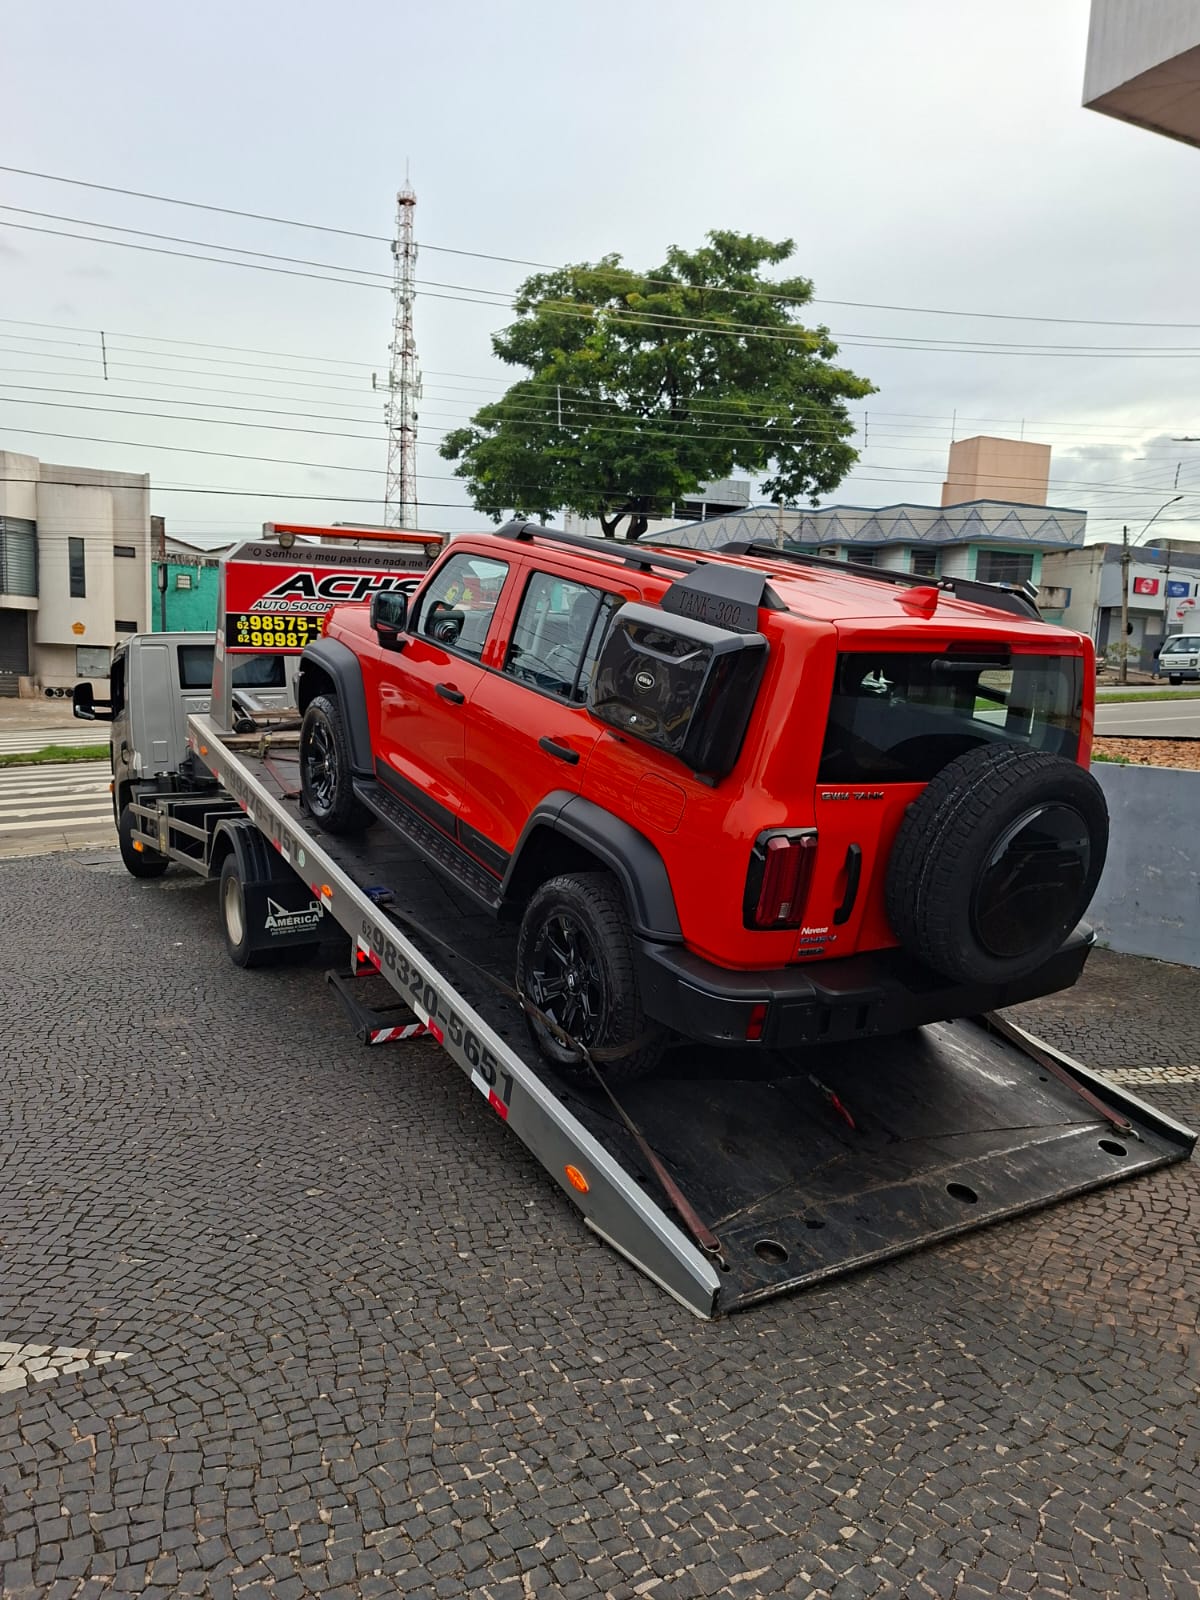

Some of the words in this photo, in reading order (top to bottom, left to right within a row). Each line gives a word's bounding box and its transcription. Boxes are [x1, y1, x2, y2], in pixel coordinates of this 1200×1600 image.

[265, 549, 303, 560] Senhor
[315, 553, 337, 562] meu
[339, 554, 372, 565] pastor
[383, 558, 406, 567] nada
[252, 600, 288, 610] AUTO
[679, 591, 742, 625] TANK-300
[237, 621, 249, 630] 62
[237, 634, 250, 643] 62
[852, 791, 885, 801] TANK
[362, 919, 372, 940] 62
[372, 926, 514, 1107] 98320-5651
